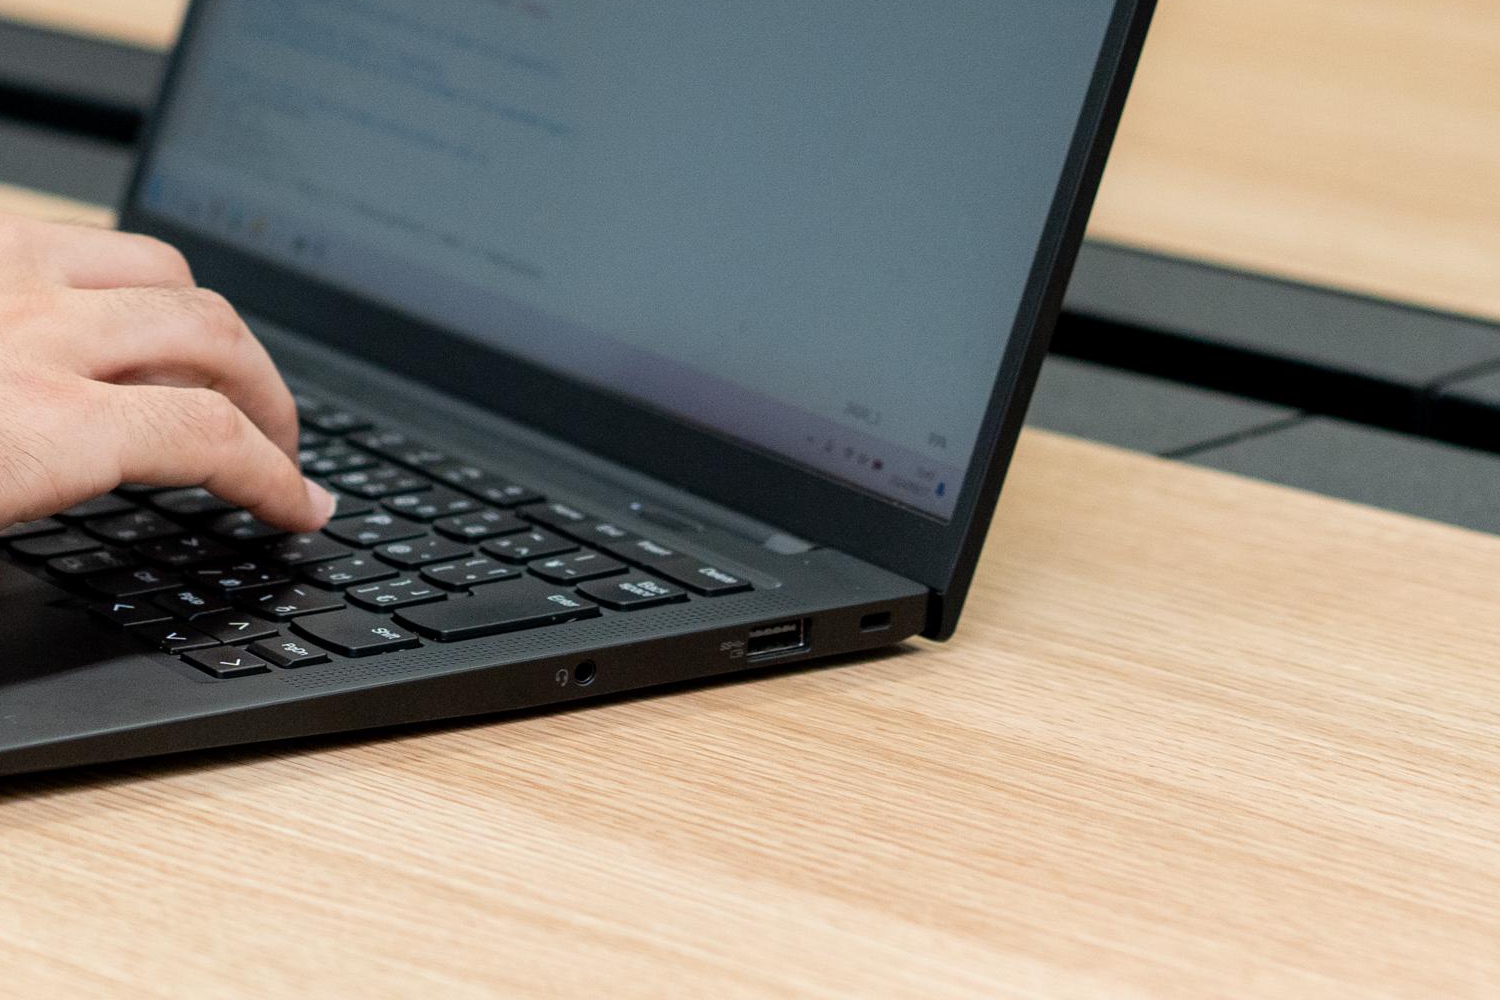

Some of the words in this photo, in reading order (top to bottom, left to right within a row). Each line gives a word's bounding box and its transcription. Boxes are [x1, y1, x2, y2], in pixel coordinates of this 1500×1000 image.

[546, 594, 581, 608] Enter
[370, 626, 402, 641] Shift
[281, 642, 309, 657] PgDn
